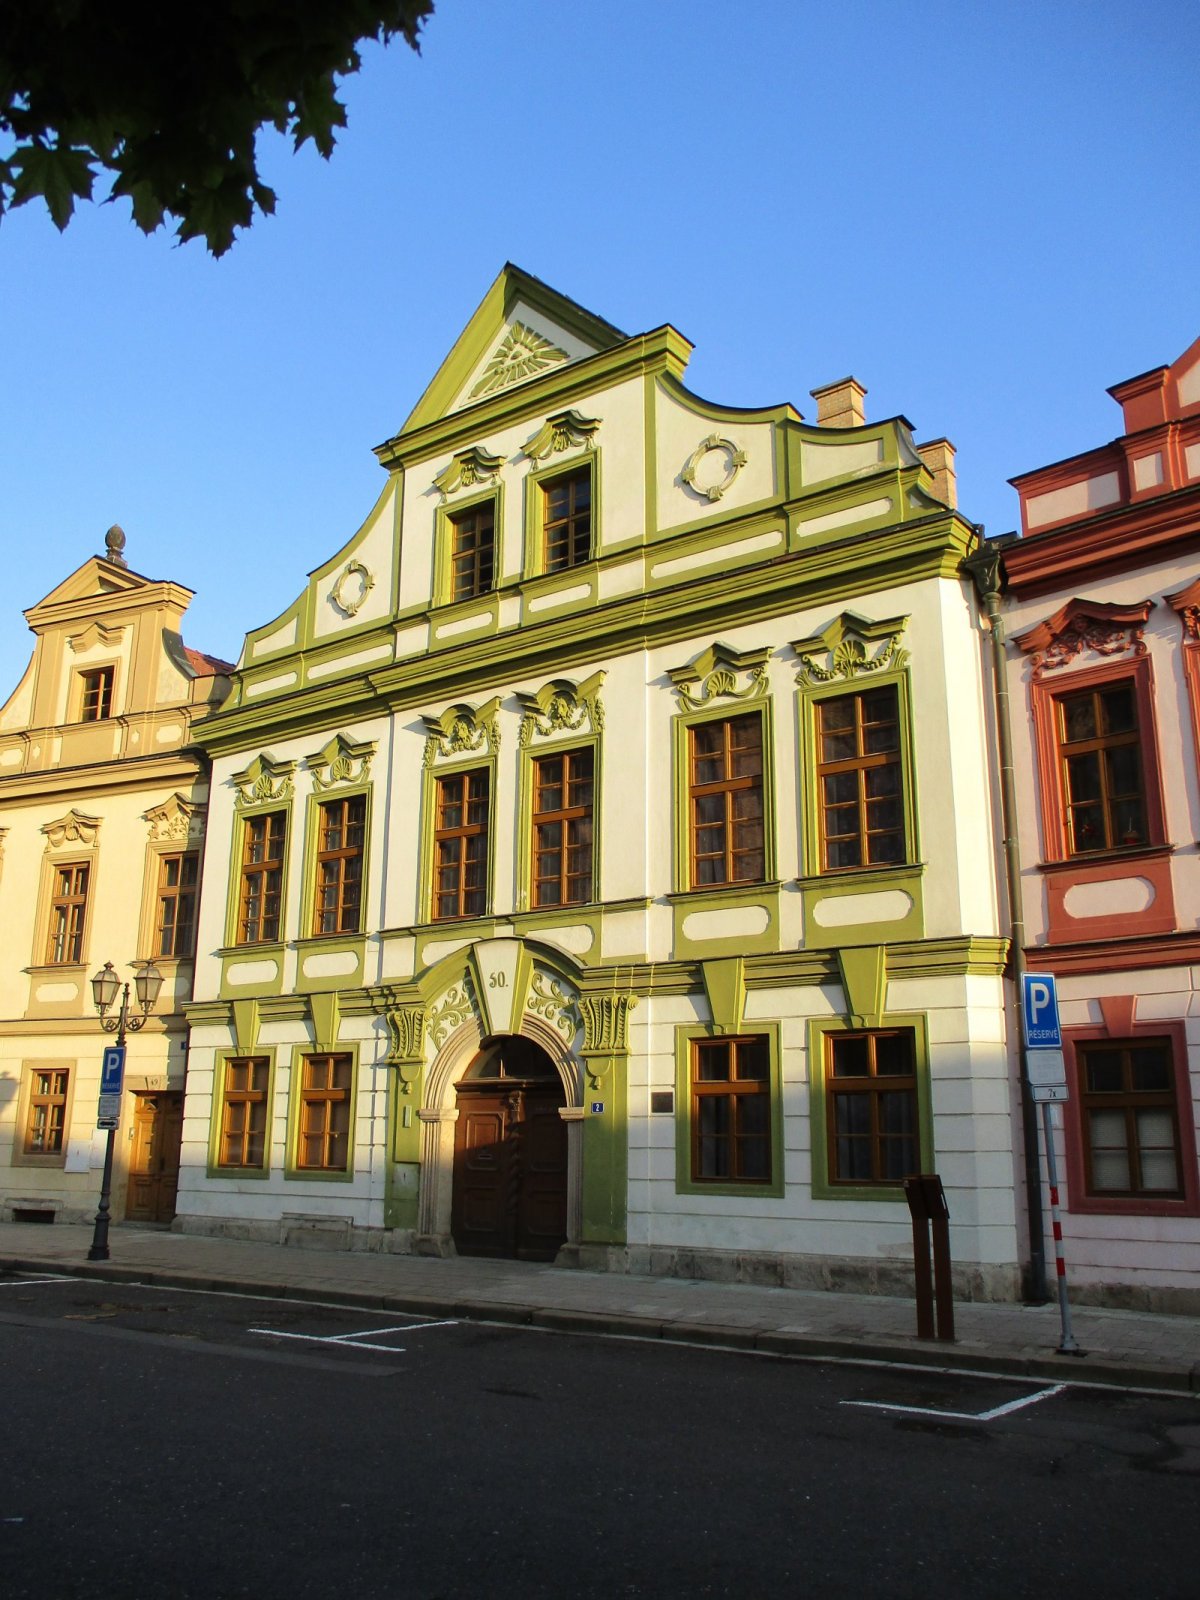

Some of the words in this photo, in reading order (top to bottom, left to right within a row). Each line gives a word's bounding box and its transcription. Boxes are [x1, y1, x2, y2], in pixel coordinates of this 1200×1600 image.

[1030, 982, 1050, 1024] P
[1028, 1028, 1059, 1039] RÉSERVÉ
[106, 1053, 120, 1080] P
[595, 1103, 600, 1112] 2
